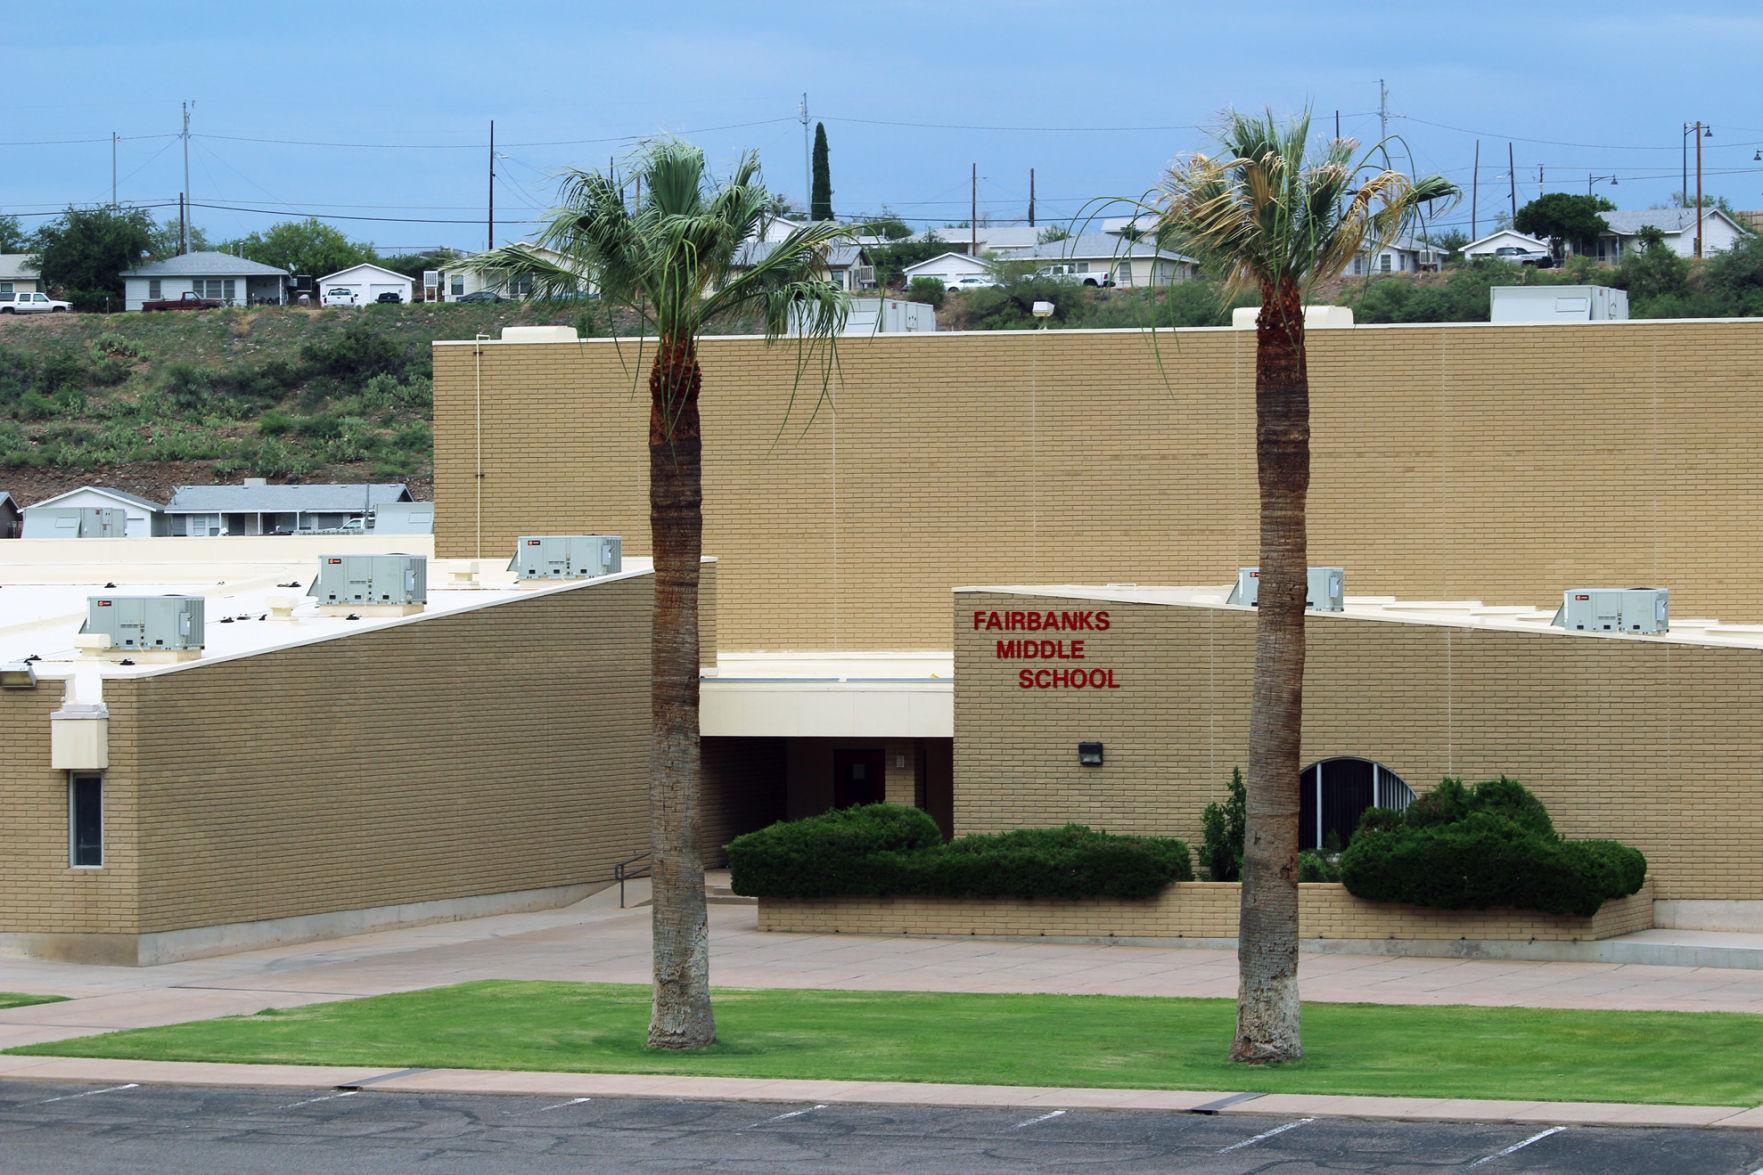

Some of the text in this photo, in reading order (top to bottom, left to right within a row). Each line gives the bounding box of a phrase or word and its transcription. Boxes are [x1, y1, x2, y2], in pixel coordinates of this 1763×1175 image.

[974, 611, 1110, 631] FAIRBANKS
[996, 640, 1085, 659] MIDDLE
[1019, 669, 1120, 689] SCHOOL
